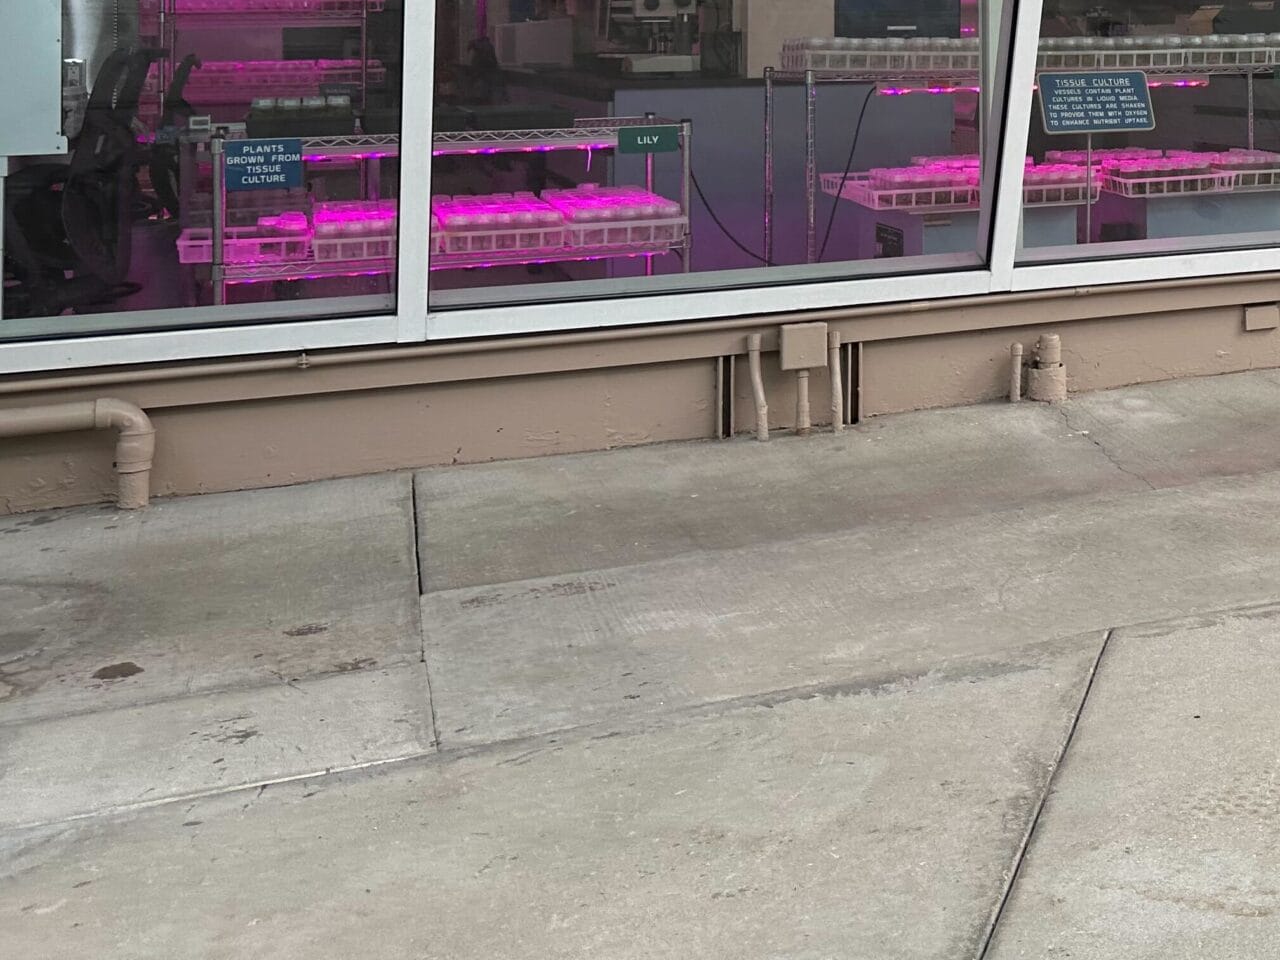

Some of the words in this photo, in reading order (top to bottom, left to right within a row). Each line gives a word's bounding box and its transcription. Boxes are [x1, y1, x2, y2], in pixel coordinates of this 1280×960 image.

[1055, 79, 1087, 87] TISSUE
[1092, 78, 1131, 87] CULTURE
[637, 135, 659, 144] LILY
[243, 145, 284, 153] PLANTS
[226, 156, 265, 164] GROWN
[271, 154, 300, 162] FROM
[246, 165, 281, 173] TISSUE
[242, 174, 286, 183] CULTURE
